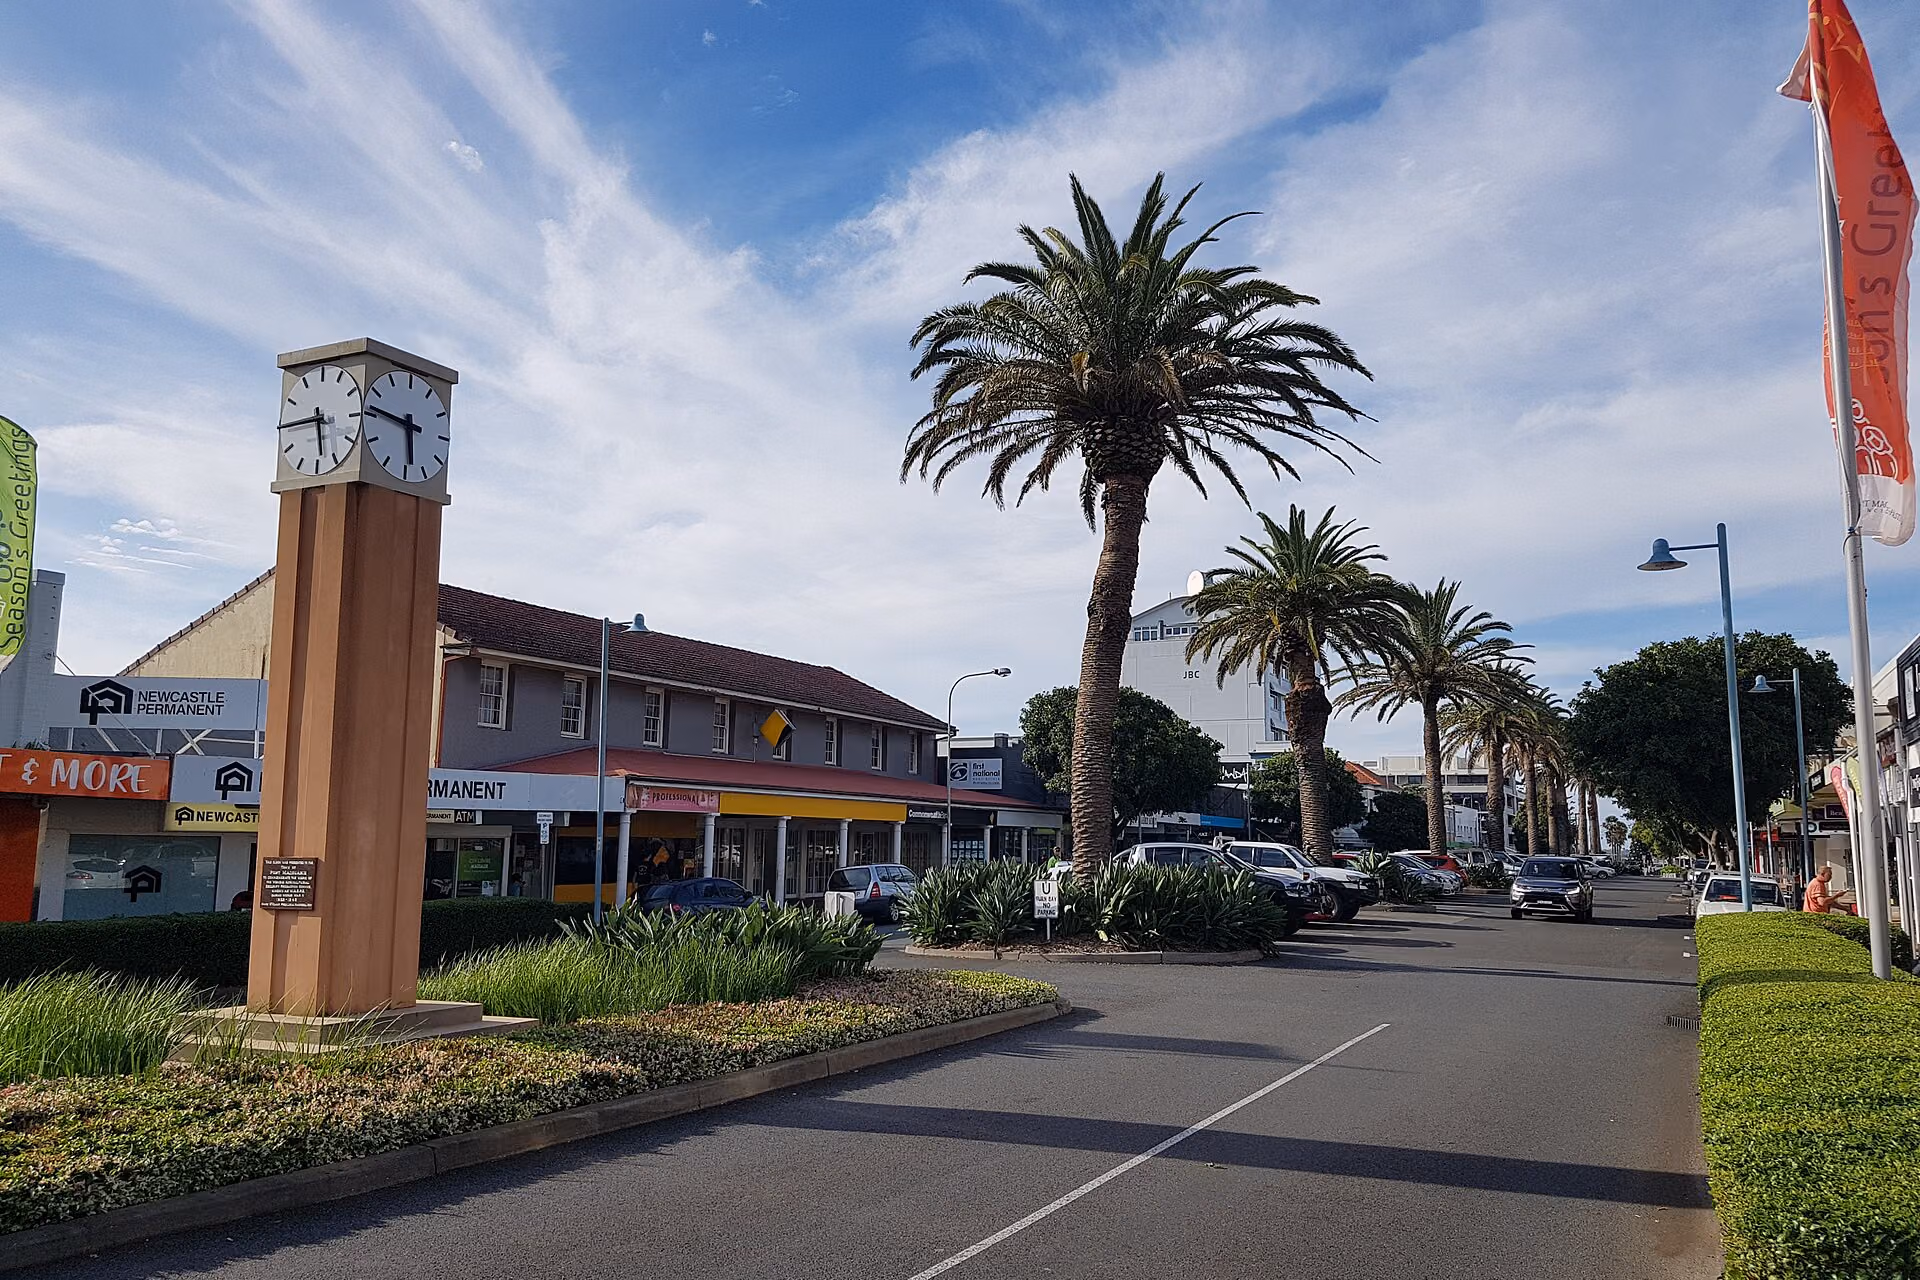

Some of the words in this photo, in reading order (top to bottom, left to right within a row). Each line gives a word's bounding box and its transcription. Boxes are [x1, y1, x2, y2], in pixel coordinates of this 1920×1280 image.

[8, 428, 31, 540] Greetings
[1183, 670, 1199, 679] JBC
[138, 690, 225, 704] NEWCASTLE
[137, 703, 225, 716] PERMANENT
[972, 762, 985, 770] first
[51, 758, 151, 793] MORE
[427, 779, 507, 800] RMANENT
[196, 811, 260, 823] NEWCAST
[455, 811, 475, 822] ATM
[1042, 882, 1051, 895] U
